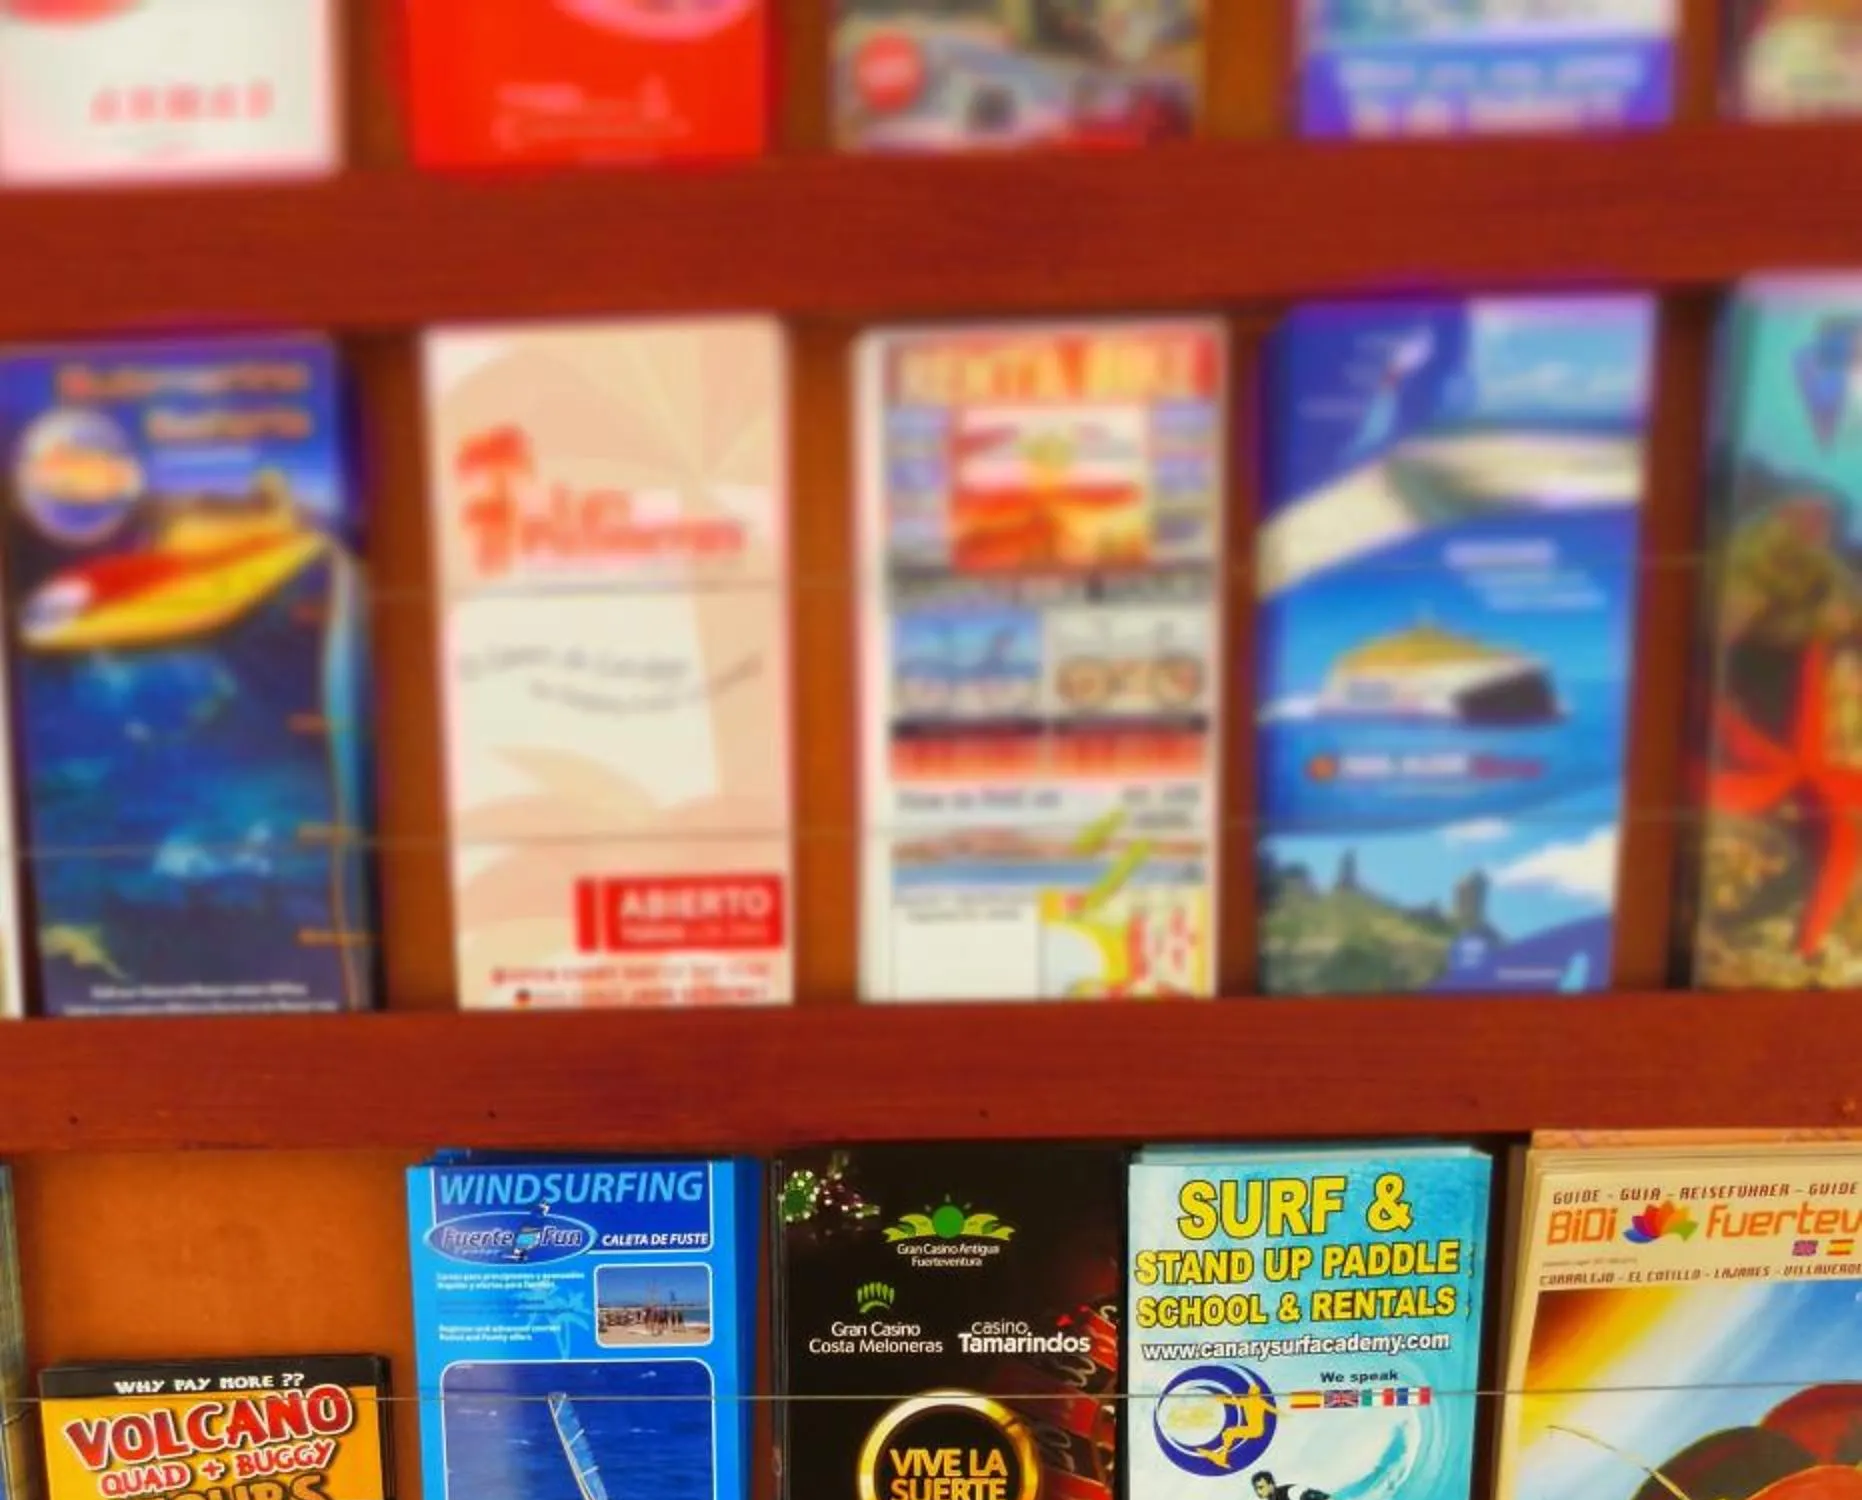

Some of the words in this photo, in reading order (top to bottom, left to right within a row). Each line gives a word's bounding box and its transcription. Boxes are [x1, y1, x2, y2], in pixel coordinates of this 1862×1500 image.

[618, 885, 773, 918] ABIERTO
[440, 1170, 703, 1205] WINDSURFING
[1553, 1189, 1600, 1205] GUIDE
[1809, 1181, 1858, 1196] GUIDE
[1177, 1175, 1347, 1240] SURF
[1366, 1171, 1414, 1233] &
[540, 1225, 582, 1247] Fun
[602, 1234, 649, 1247] CALETA
[651, 1233, 668, 1246] DE
[669, 1232, 709, 1245] FUSTE
[897, 1243, 922, 1255] Gran
[924, 1243, 958, 1255] Casino
[911, 1256, 983, 1267] Fuerteventura
[1134, 1249, 1254, 1286] STAND
[1263, 1246, 1313, 1283] UP
[1322, 1240, 1460, 1280] PADDLE
[1135, 1293, 1268, 1329] SCHOOL
[1276, 1291, 1301, 1324] &
[1310, 1286, 1457, 1322] RENTALS
[831, 1321, 867, 1337] Gran
[871, 1321, 921, 1337] Casino
[971, 1318, 1029, 1334] casino
[809, 1338, 855, 1353] Costa
[859, 1338, 943, 1353] Meloneras
[958, 1331, 1091, 1353] Tamarindos
[1142, 1332, 1450, 1363] www.canarysurfacademy.com
[114, 1379, 165, 1394] WHY
[173, 1377, 211, 1392] PAY
[220, 1375, 274, 1390] MORE
[1321, 1371, 1345, 1384] We
[1350, 1369, 1399, 1386] speak
[65, 1384, 353, 1470] VOLCANO
[100, 1461, 191, 1499] QUAD
[202, 1458, 226, 1482] +
[235, 1438, 337, 1479] BUGGY
[890, 1449, 962, 1477] VIVE
[969, 1449, 1008, 1477] LA
